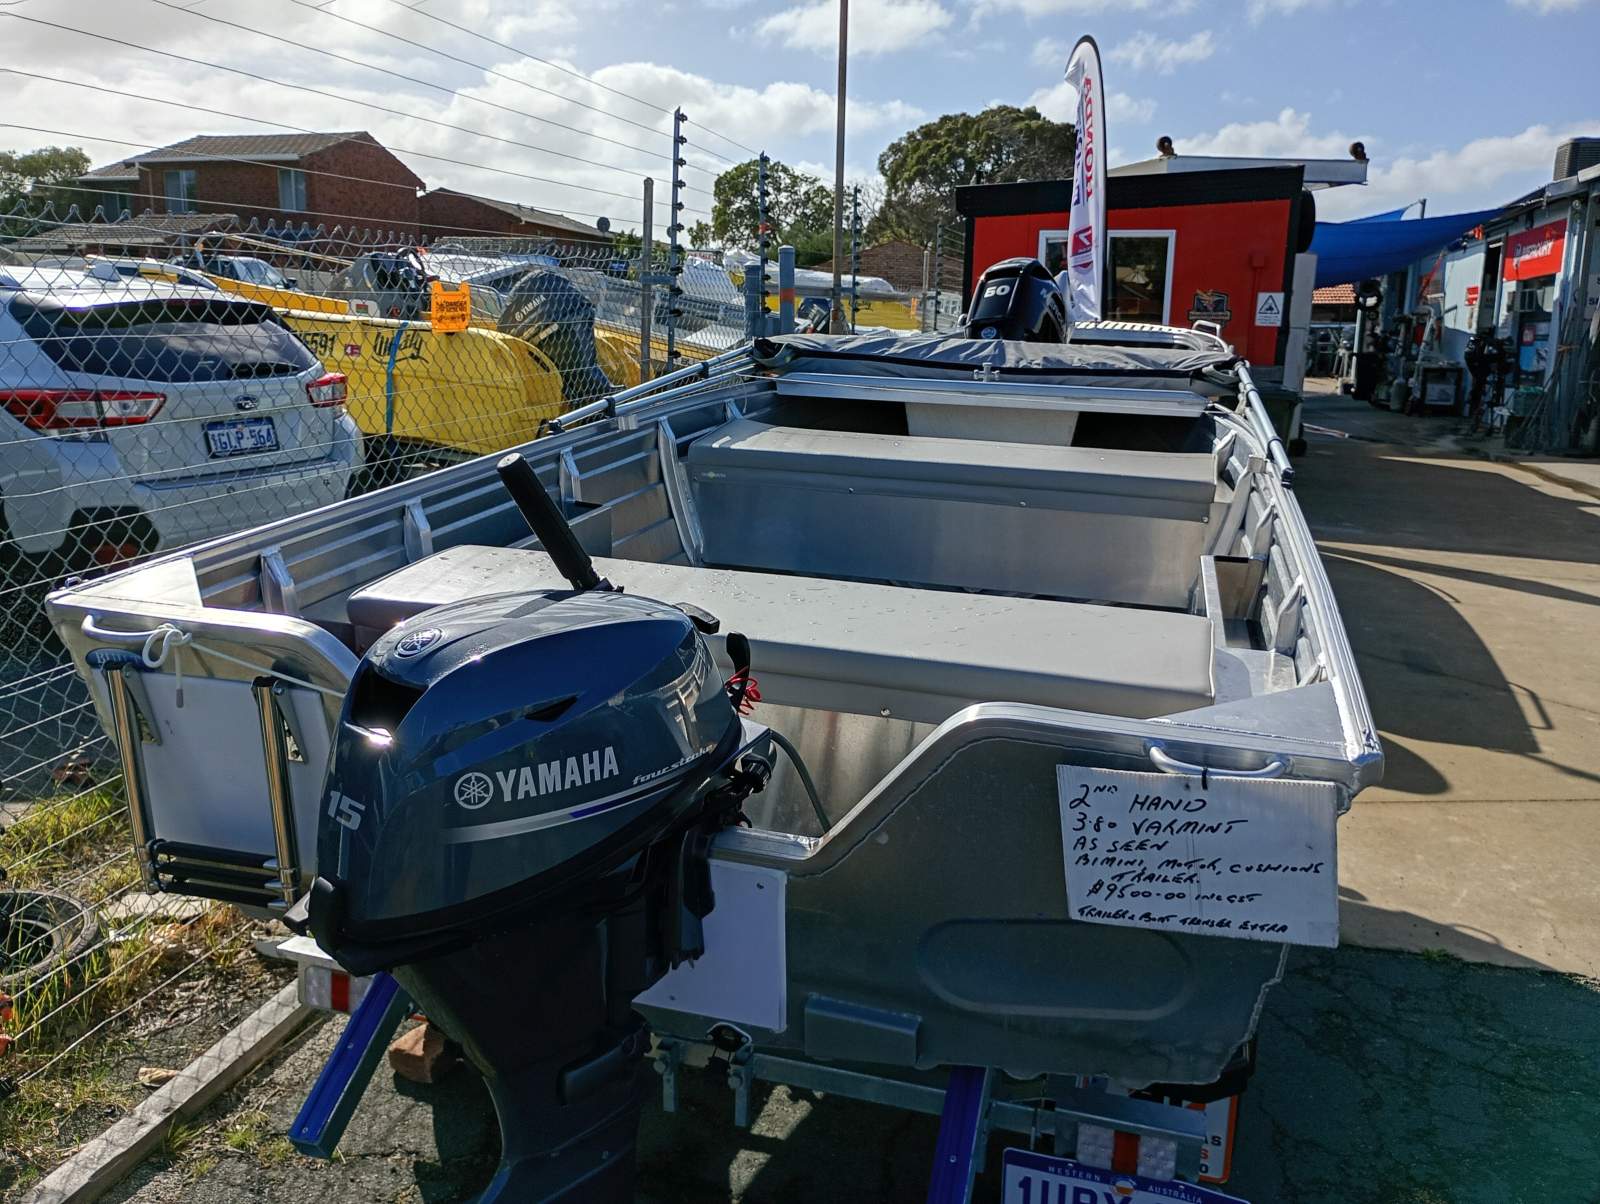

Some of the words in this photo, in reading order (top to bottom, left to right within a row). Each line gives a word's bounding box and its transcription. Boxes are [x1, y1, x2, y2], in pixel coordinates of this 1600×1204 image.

[495, 745, 620, 802] YAMAHA
[327, 789, 366, 831] 15
[1128, 793, 1208, 814] HAND
[1131, 818, 1249, 836] VARMINT
[1073, 835, 1099, 852] AS
[1106, 838, 1169, 853] SEEN
[1229, 862, 1325, 875] CUSHIONS
[1238, 920, 1289, 933] EXTRA
[1047, 1165, 1102, 1183] WESTERN
[1147, 1184, 1204, 1204] AUSTRALIA
